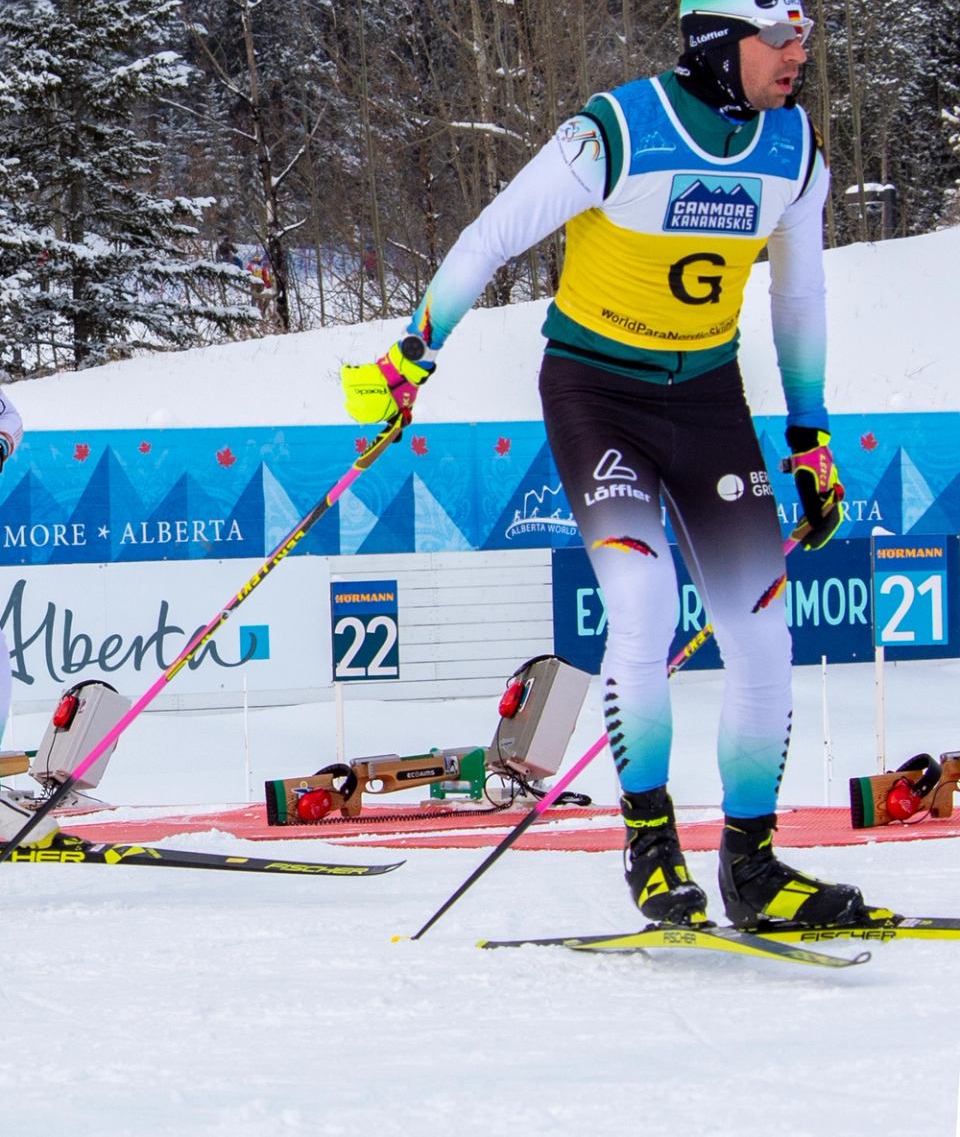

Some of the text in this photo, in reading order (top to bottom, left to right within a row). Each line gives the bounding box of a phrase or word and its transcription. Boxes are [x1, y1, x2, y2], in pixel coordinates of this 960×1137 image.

[674, 200, 756, 218] CANMORE
[671, 214, 754, 231] KANANASKIS
[668, 252, 727, 305] G
[120, 518, 244, 546] ALBERTA
[510, 523, 577, 537] ALBERTA WORLD
[879, 574, 943, 642] 21
[334, 615, 398, 677] 22
[263, 862, 370, 876] FISCHER
[663, 930, 697, 945] FISCHER
[800, 930, 897, 942] FISCHER
